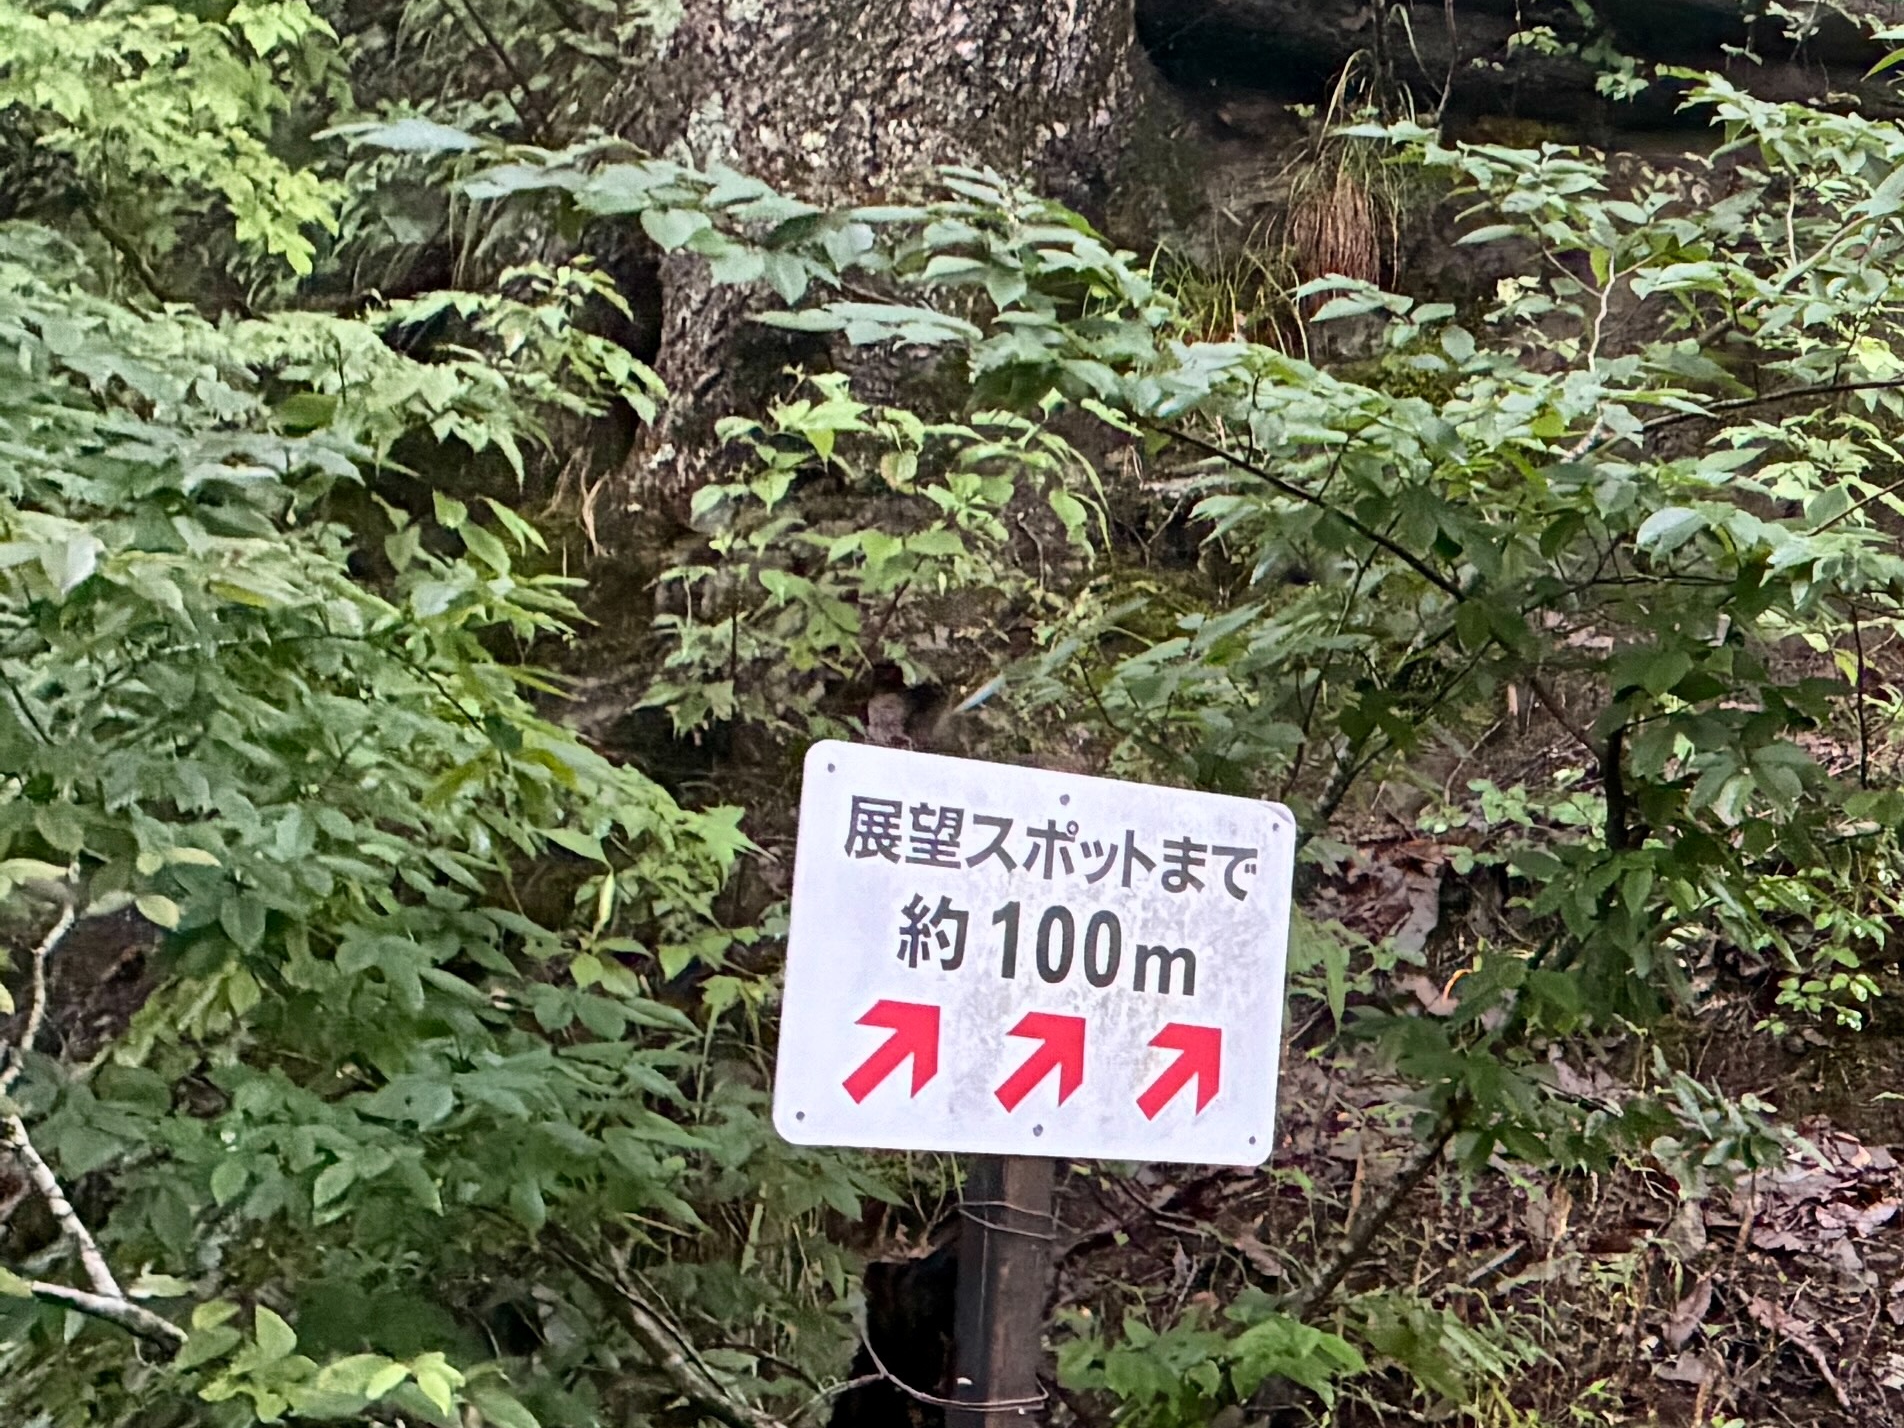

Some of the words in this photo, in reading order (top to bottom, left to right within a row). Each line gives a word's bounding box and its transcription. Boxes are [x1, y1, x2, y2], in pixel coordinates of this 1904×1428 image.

[844, 795, 1258, 901] 展望スポットまで
